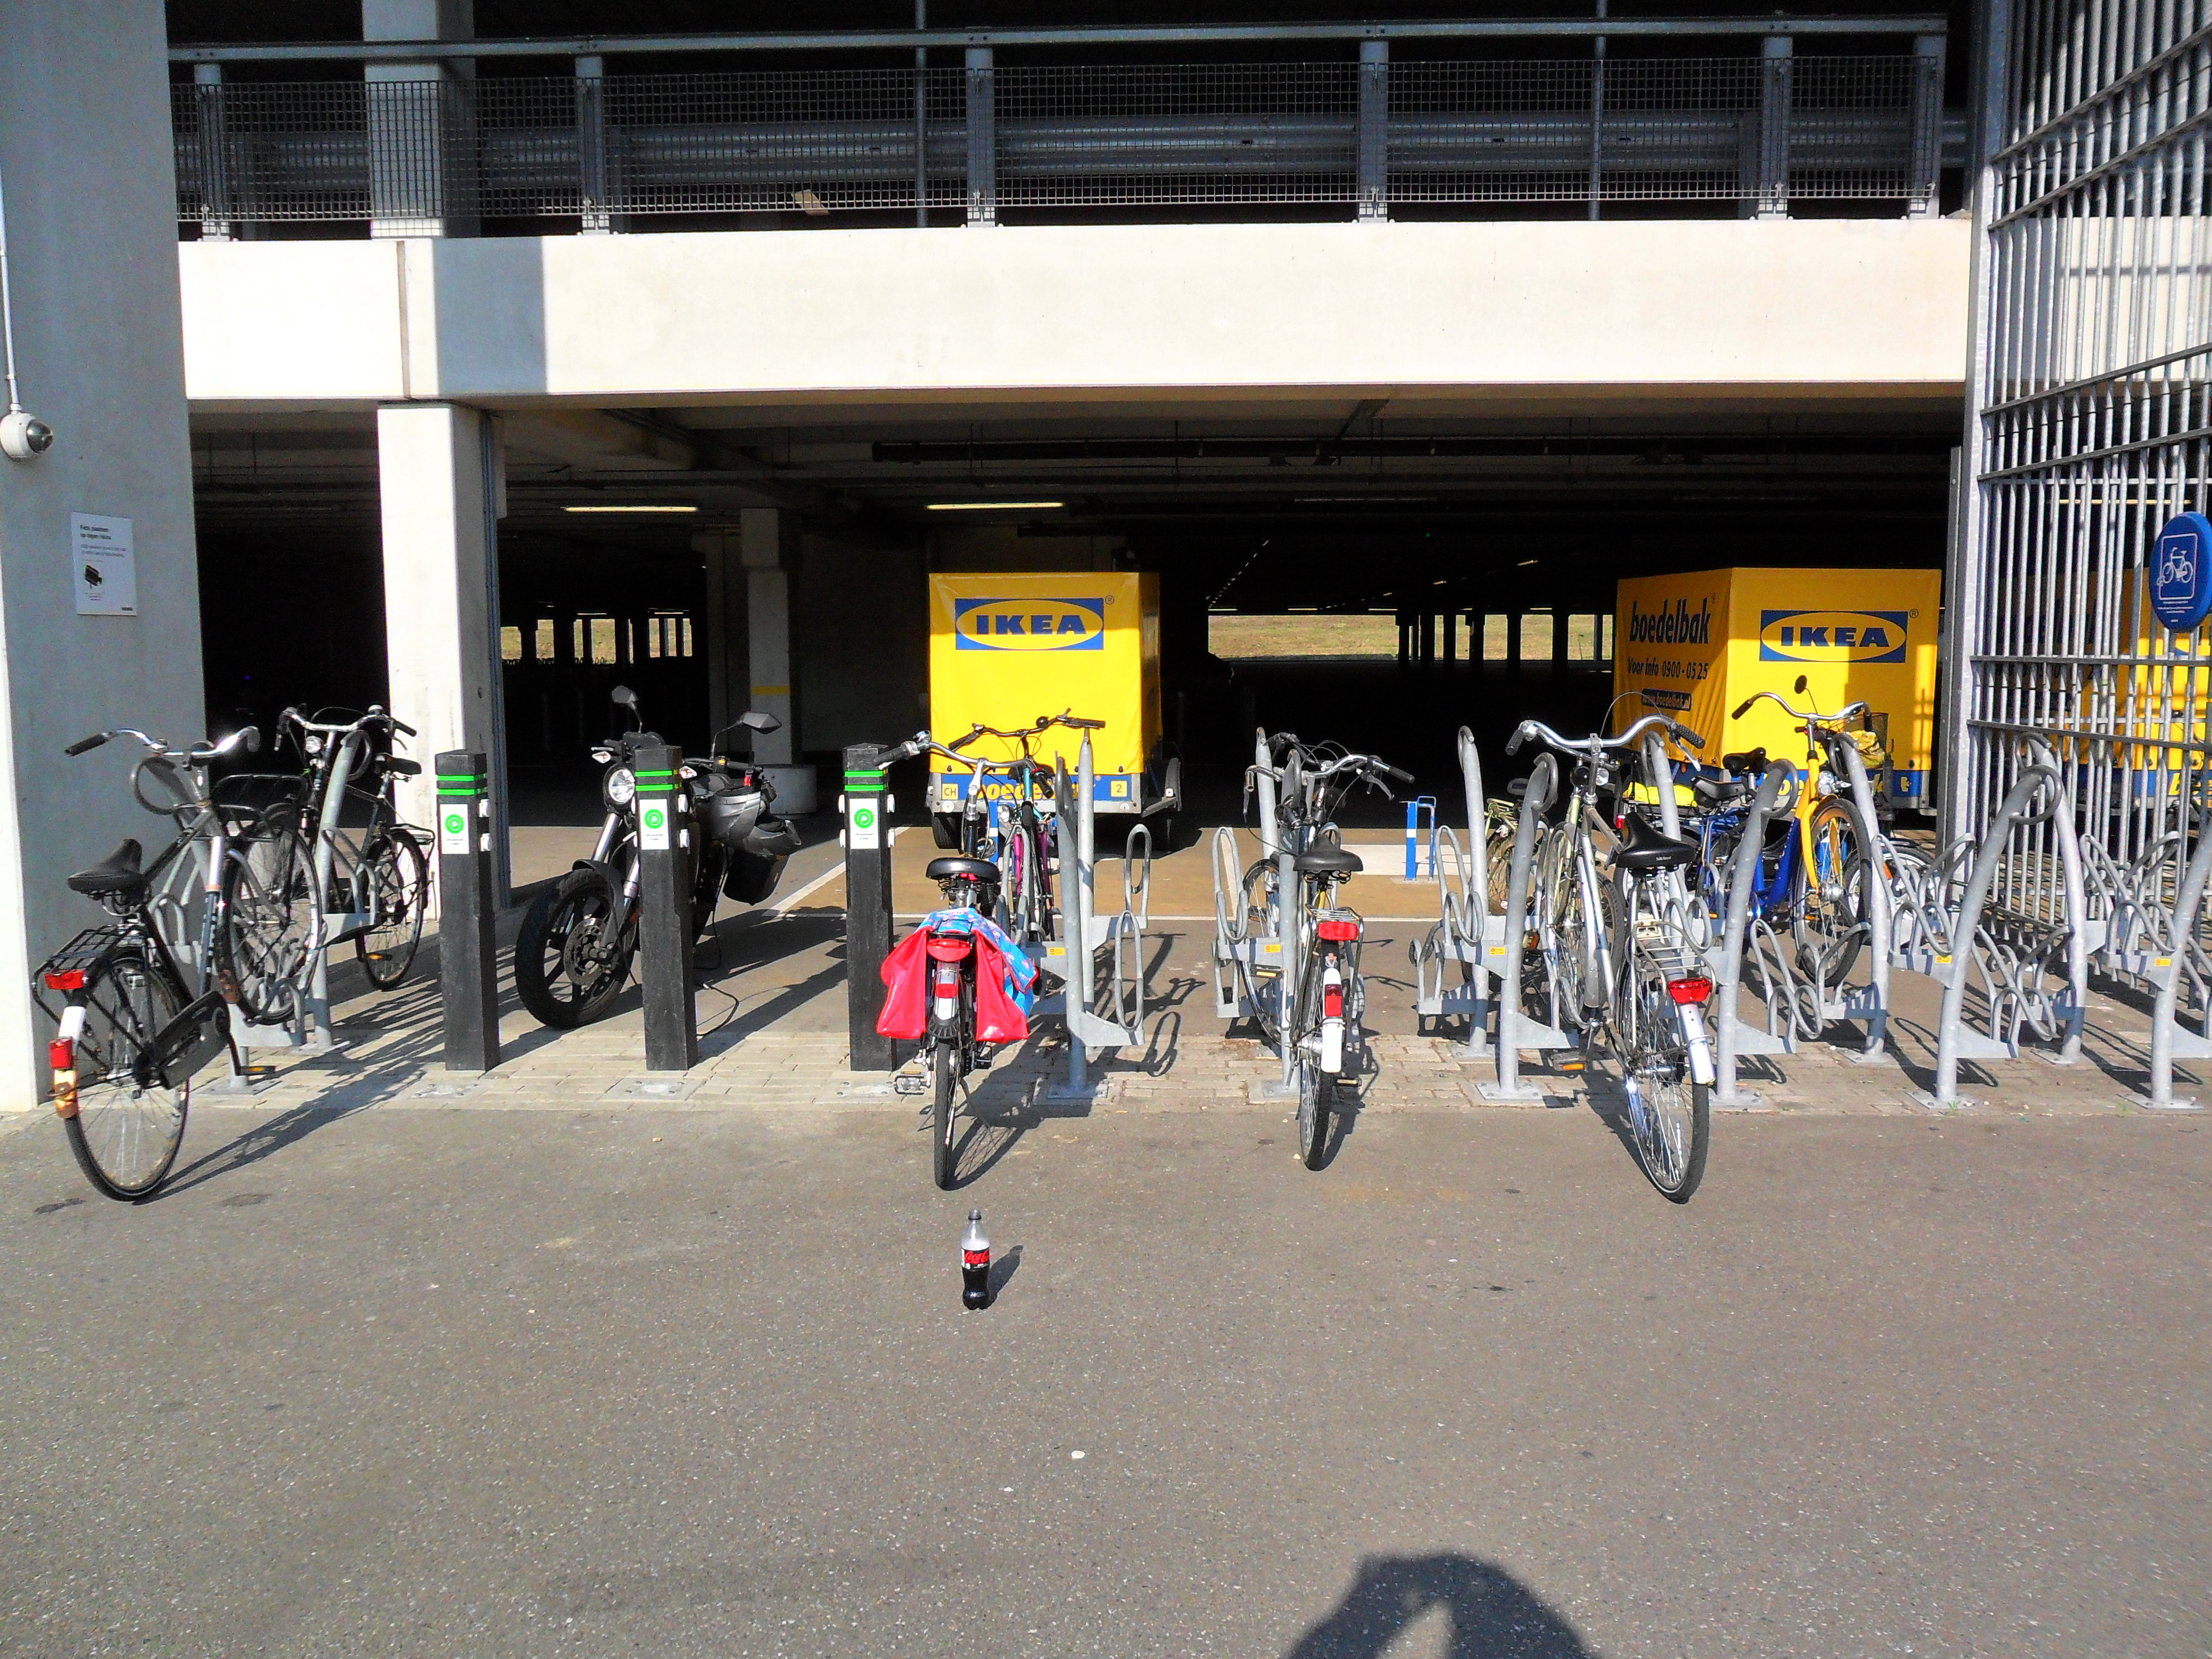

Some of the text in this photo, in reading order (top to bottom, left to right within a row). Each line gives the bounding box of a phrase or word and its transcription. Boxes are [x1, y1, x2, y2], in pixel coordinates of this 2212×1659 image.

[976, 614, 1087, 635] IKEA
[1629, 597, 1711, 644] boedelbak
[1781, 626, 1891, 647] IKEA
[1628, 657, 1644, 674] Voor
[1645, 657, 1659, 676] info
[944, 786, 957, 797] CH
[1116, 784, 1123, 793] 2
